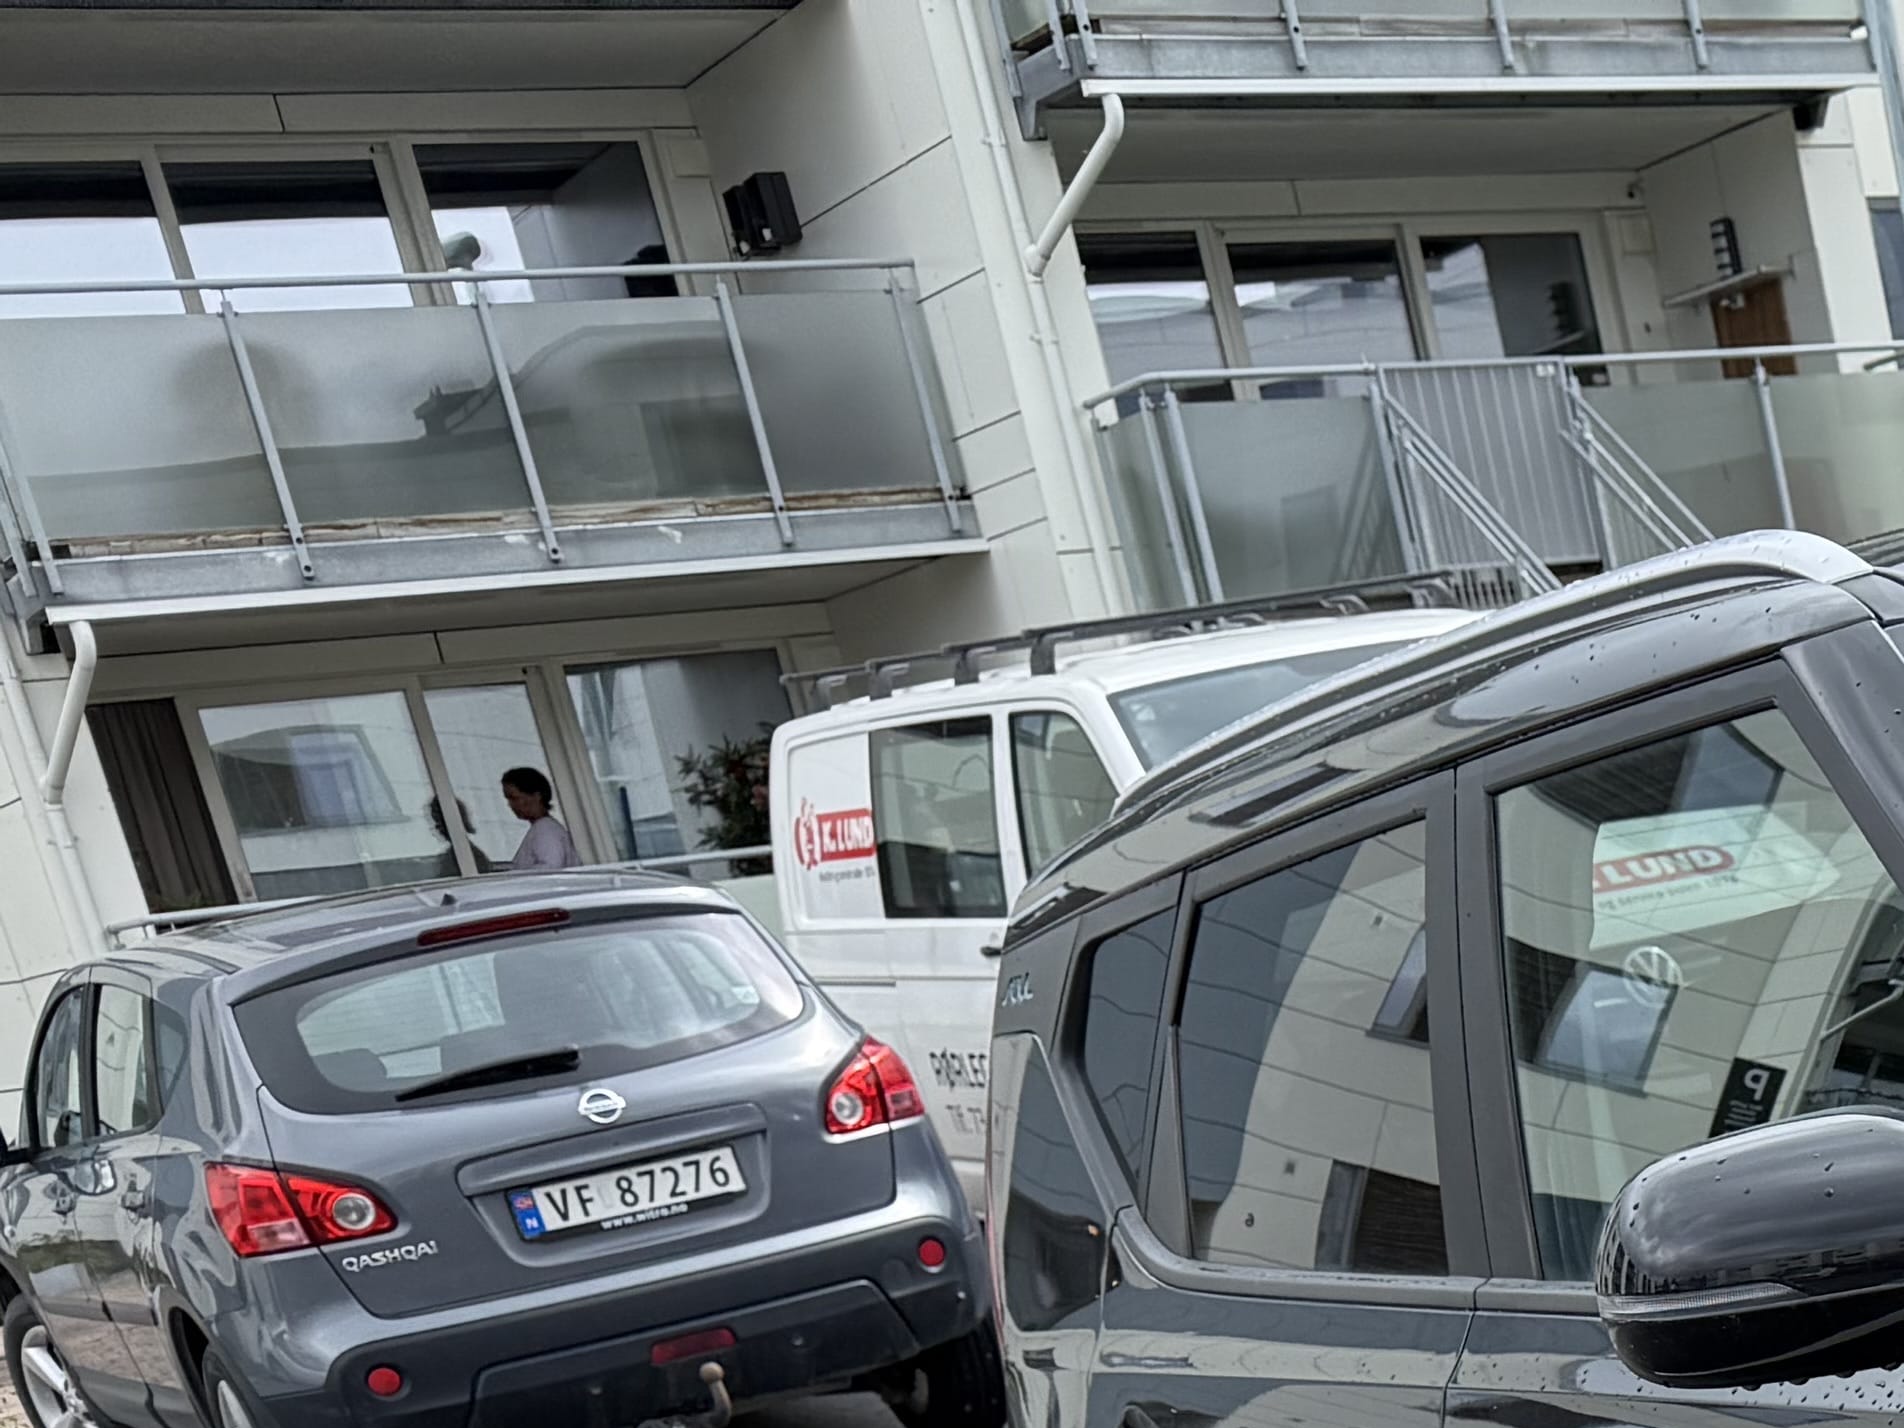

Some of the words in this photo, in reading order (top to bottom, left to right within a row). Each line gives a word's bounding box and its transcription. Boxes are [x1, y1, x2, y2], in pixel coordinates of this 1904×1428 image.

[1601, 849, 1723, 885] LUND
[545, 1184, 594, 1222] VF
[615, 1155, 731, 1207] 87276
[341, 1240, 439, 1273] QASHQAI
